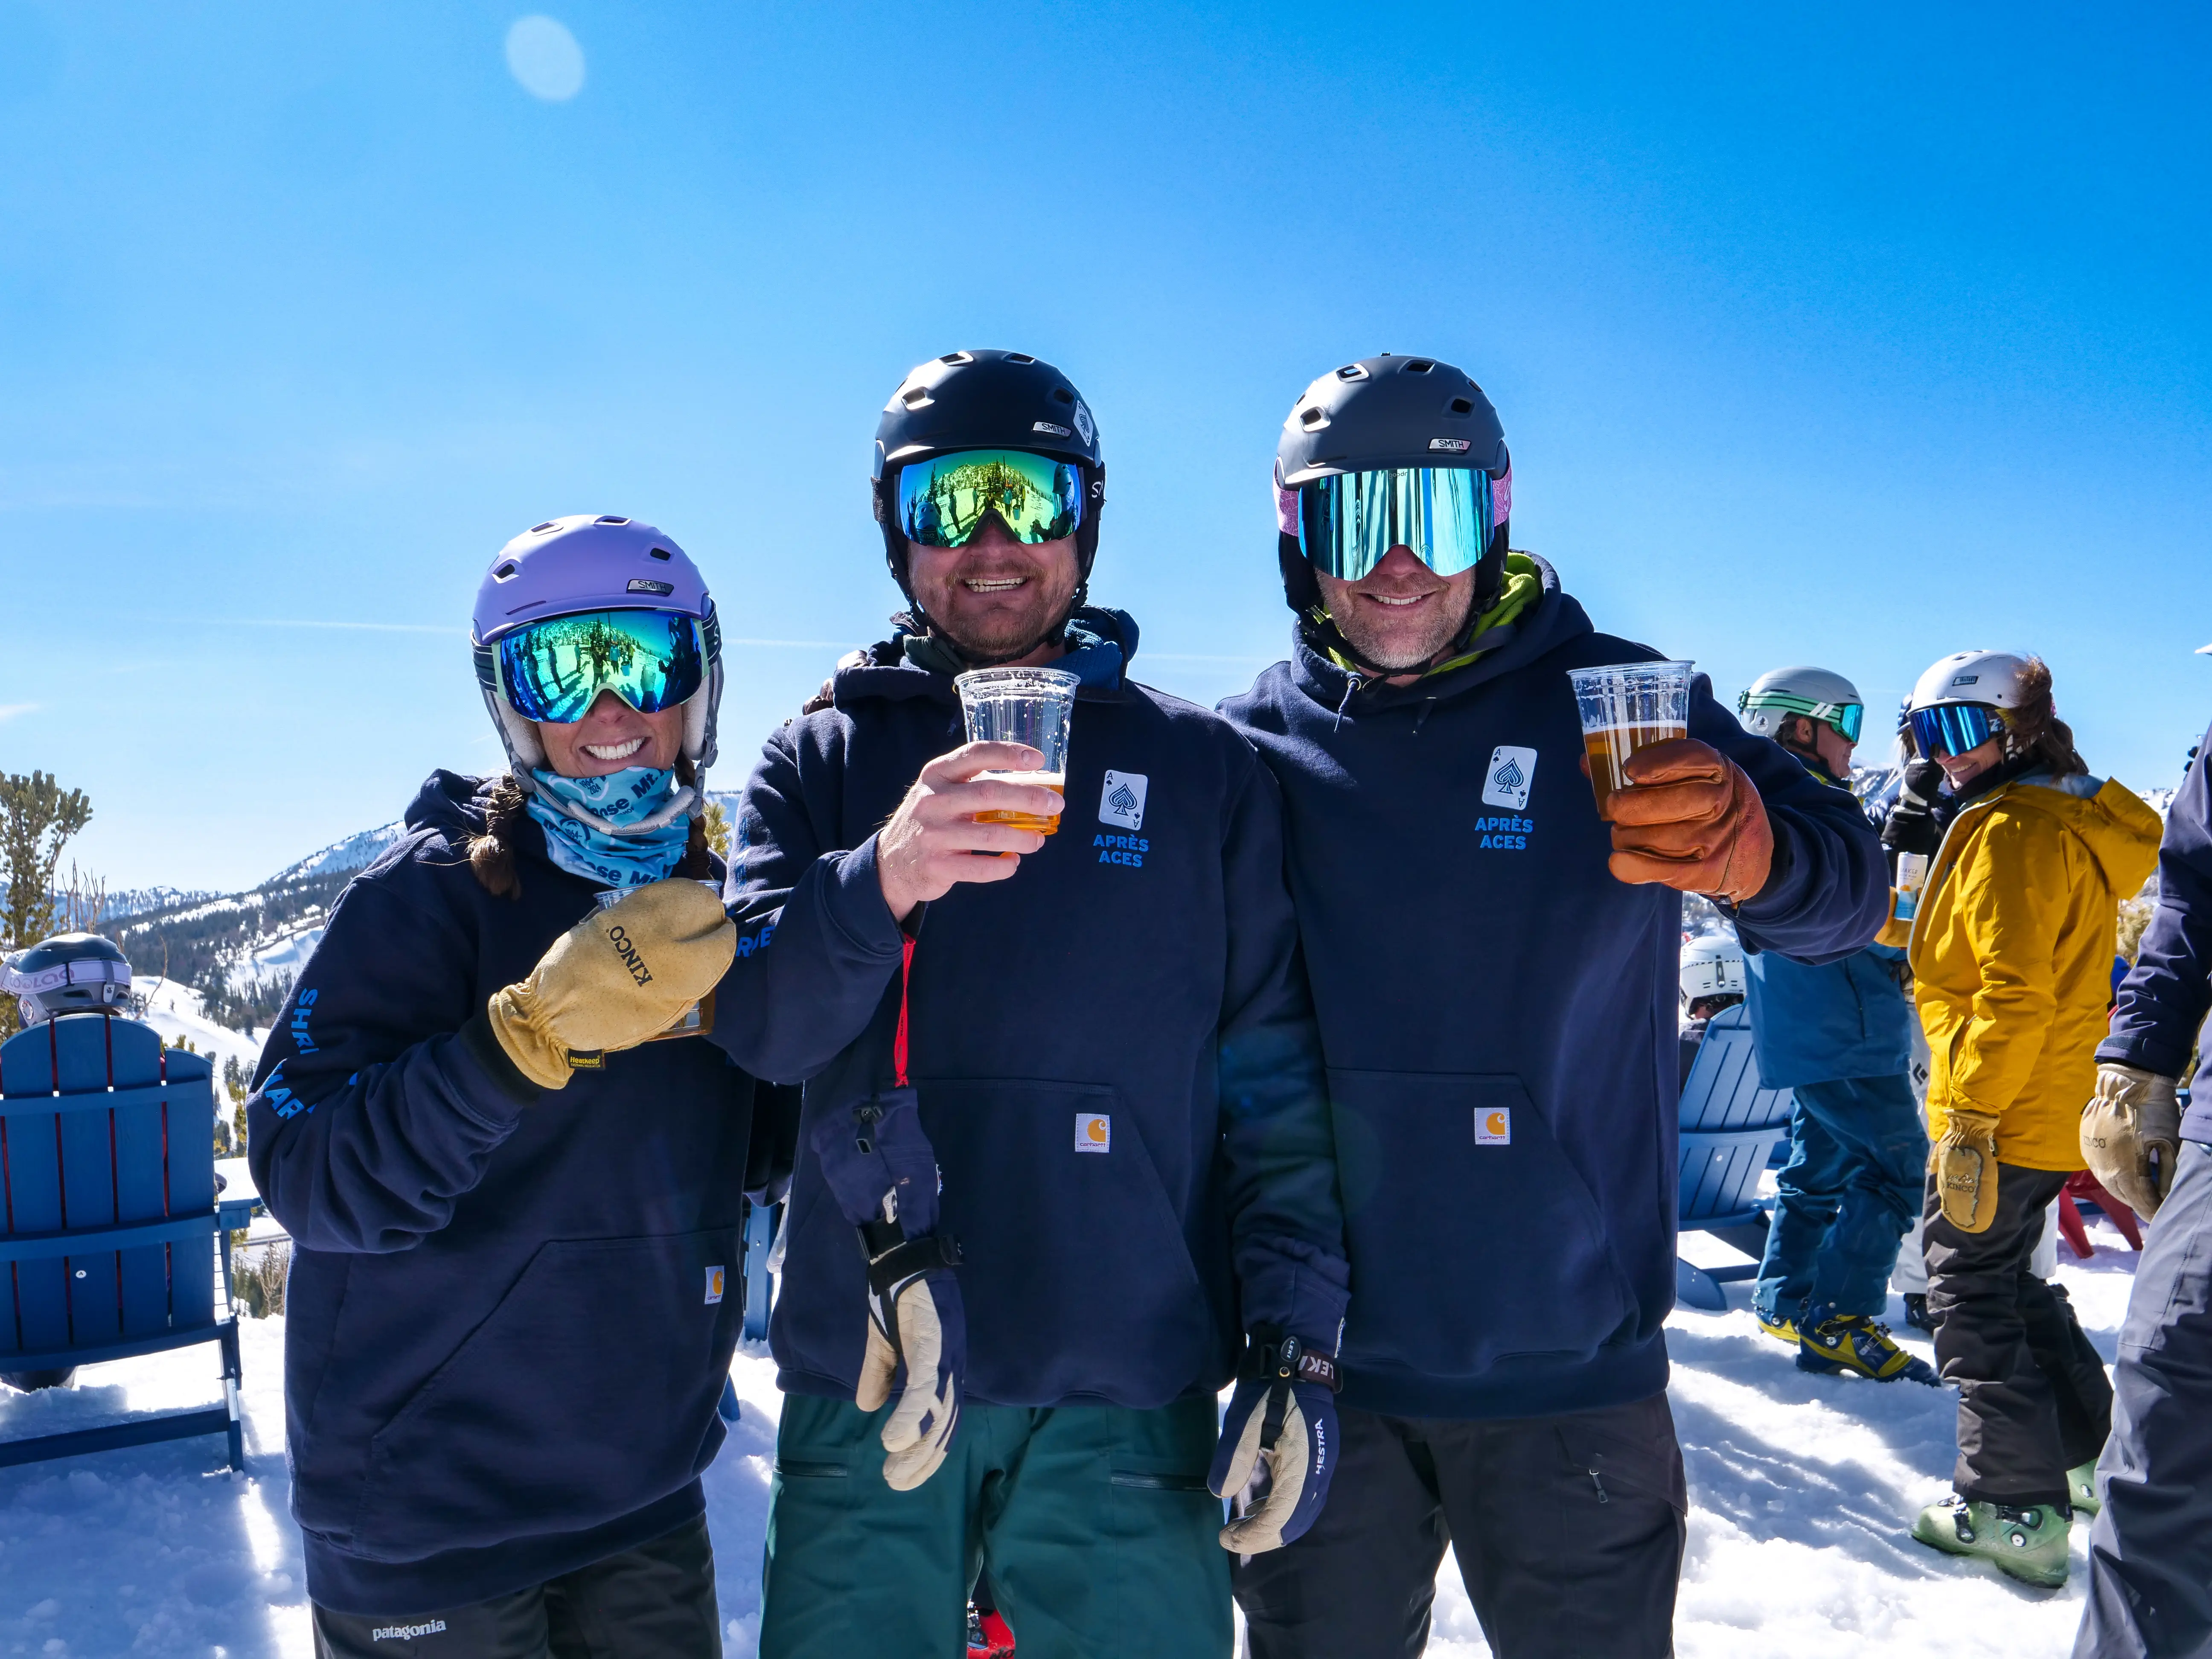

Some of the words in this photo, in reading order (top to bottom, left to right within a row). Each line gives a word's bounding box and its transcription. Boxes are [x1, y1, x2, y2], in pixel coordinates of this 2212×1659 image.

[1042, 423, 1065, 435] SMITH
[1438, 439, 1464, 448] SMITH
[638, 581, 666, 592] SMITH
[1475, 815, 1534, 833] APRÈS
[1093, 834, 1149, 852] APRÈS
[1480, 835, 1526, 850] ACES
[1099, 851, 1142, 868] ACES
[610, 926, 654, 987] KINCO
[570, 1056, 600, 1065] Heatkeep
[1286, 1340, 1295, 1359] LEKI
[1315, 1418, 1325, 1474] HESTRA
[372, 1619, 446, 1642] patagonia
